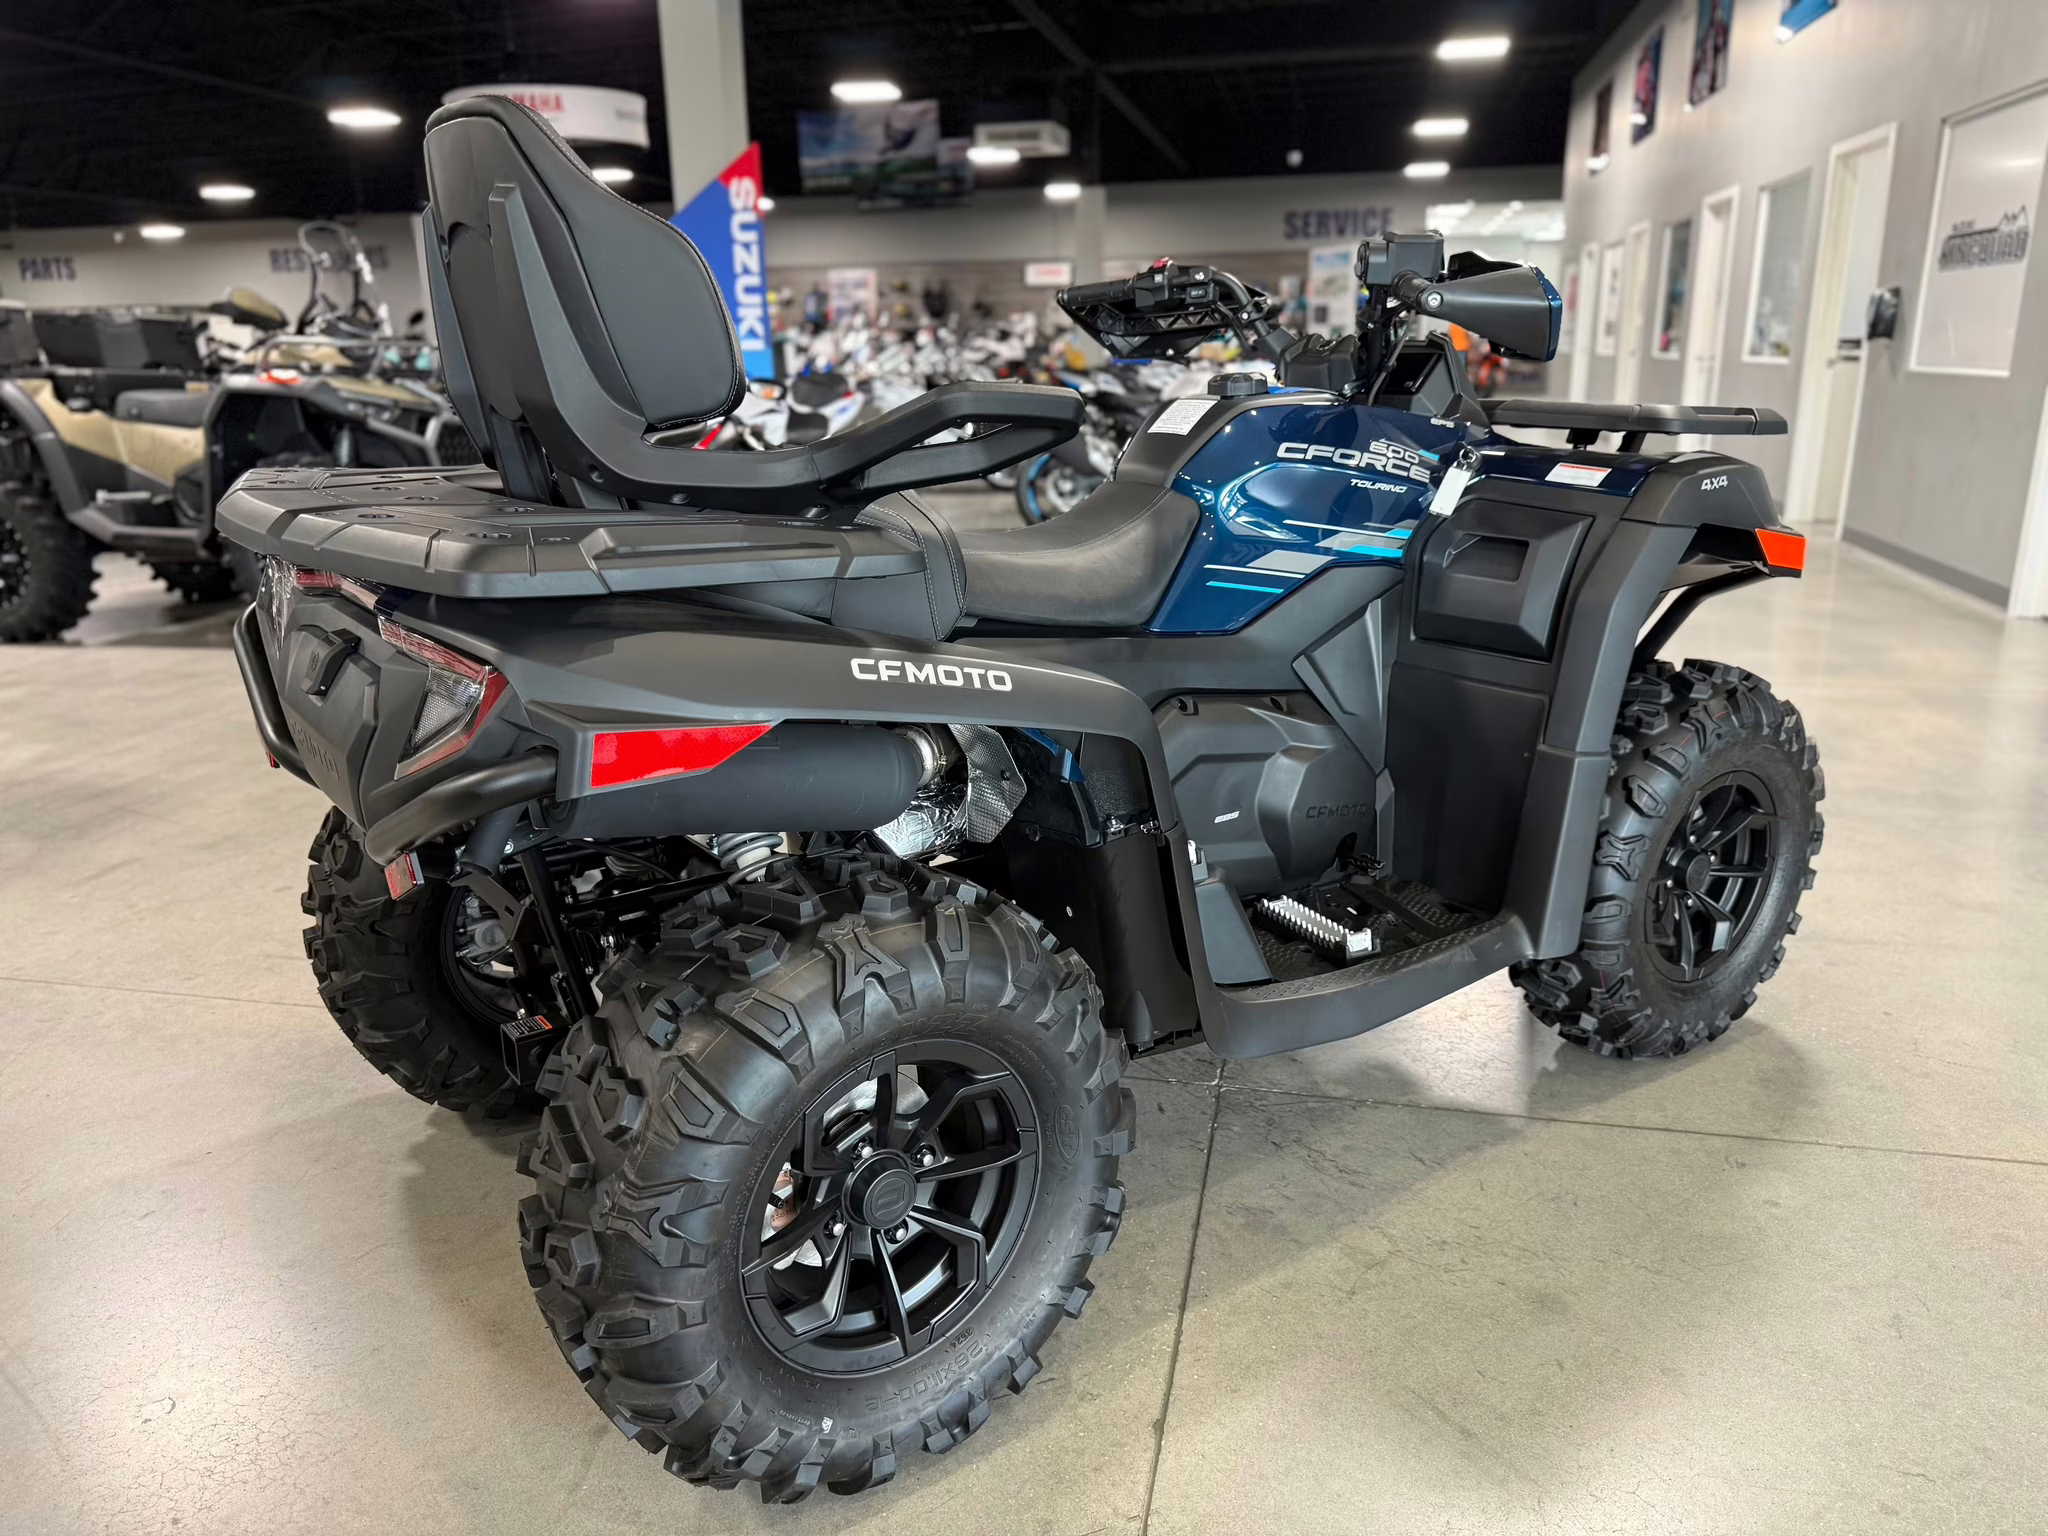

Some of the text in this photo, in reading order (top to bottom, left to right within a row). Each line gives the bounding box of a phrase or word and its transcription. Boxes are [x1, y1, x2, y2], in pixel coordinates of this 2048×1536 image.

[1284, 206, 1392, 241] SERVICE
[19, 256, 77, 283] PARTS
[728, 176, 767, 351] SUZUKI
[1430, 417, 1455, 429] EPS
[1276, 442, 1431, 483] CFORCE
[1369, 440, 1419, 464] 600
[1350, 478, 1408, 493] TOURING
[1700, 475, 1728, 490] 4X4
[850, 658, 1012, 691] CFMOTO
[1305, 803, 1368, 819] CFMOTO
